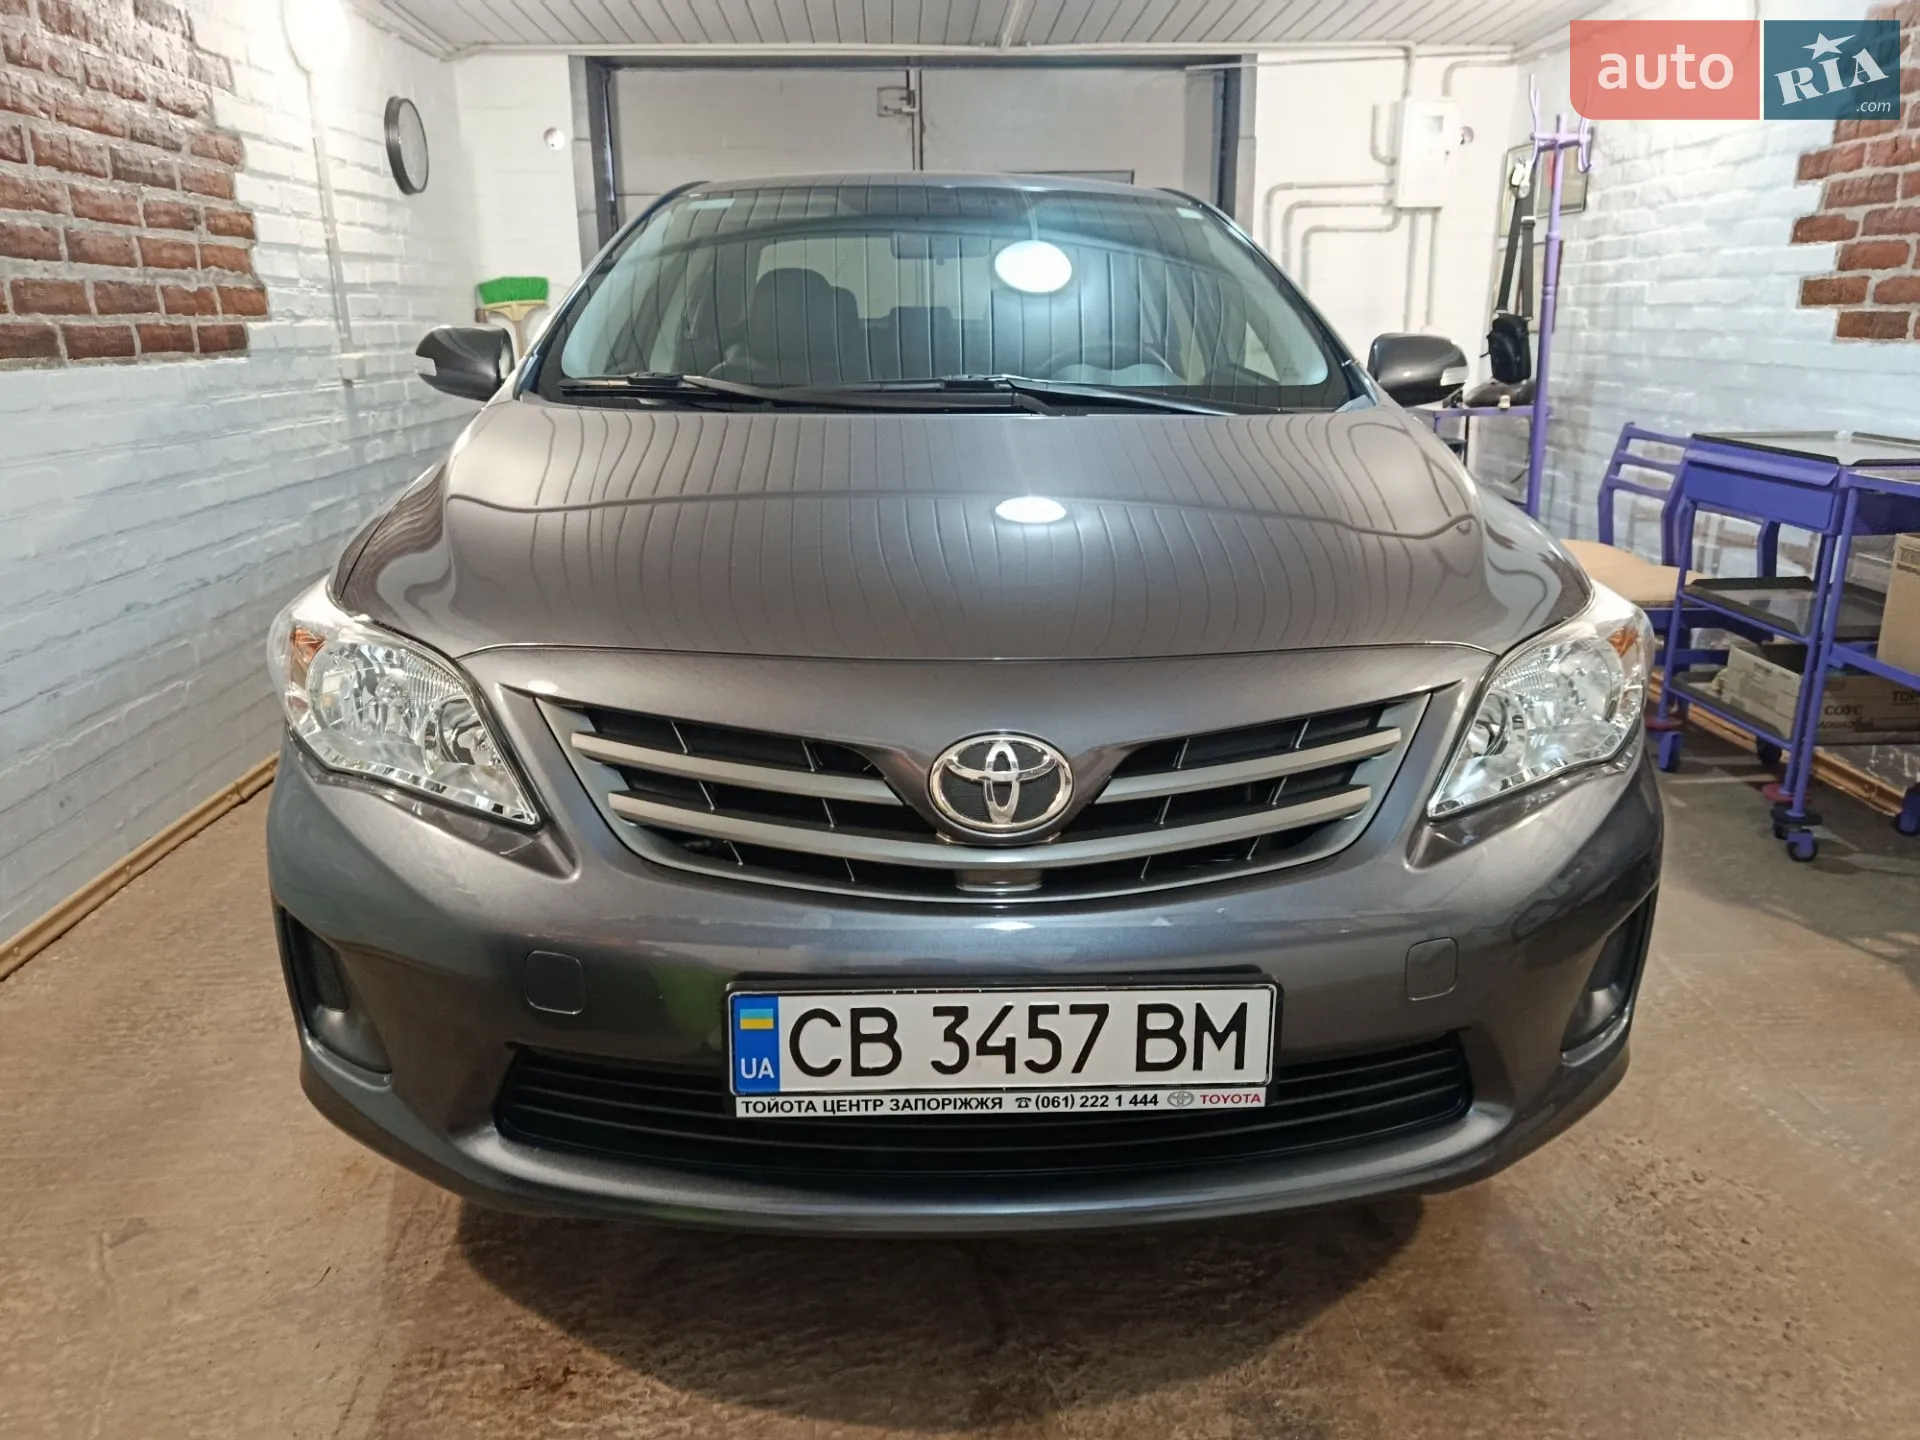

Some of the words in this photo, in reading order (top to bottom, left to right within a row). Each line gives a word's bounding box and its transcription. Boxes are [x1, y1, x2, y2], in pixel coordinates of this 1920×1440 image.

[789, 1007, 903, 1078] CB
[930, 1003, 1110, 1076] 3457
[1135, 1001, 1248, 1073] BM
[740, 1057, 775, 1080] UA
[741, 1097, 818, 1115] ТОЙОТА
[823, 1098, 884, 1115] ЦЕНТР
[889, 1096, 1003, 1113] ЗАПОРІЖЖЯ
[1035, 1094, 1075, 1110] (061)
[1079, 1094, 1109, 1108] 222
[1115, 1094, 1123, 1108] 1
[1128, 1093, 1159, 1107] 444
[1200, 1093, 1262, 1105] TOYOTA
